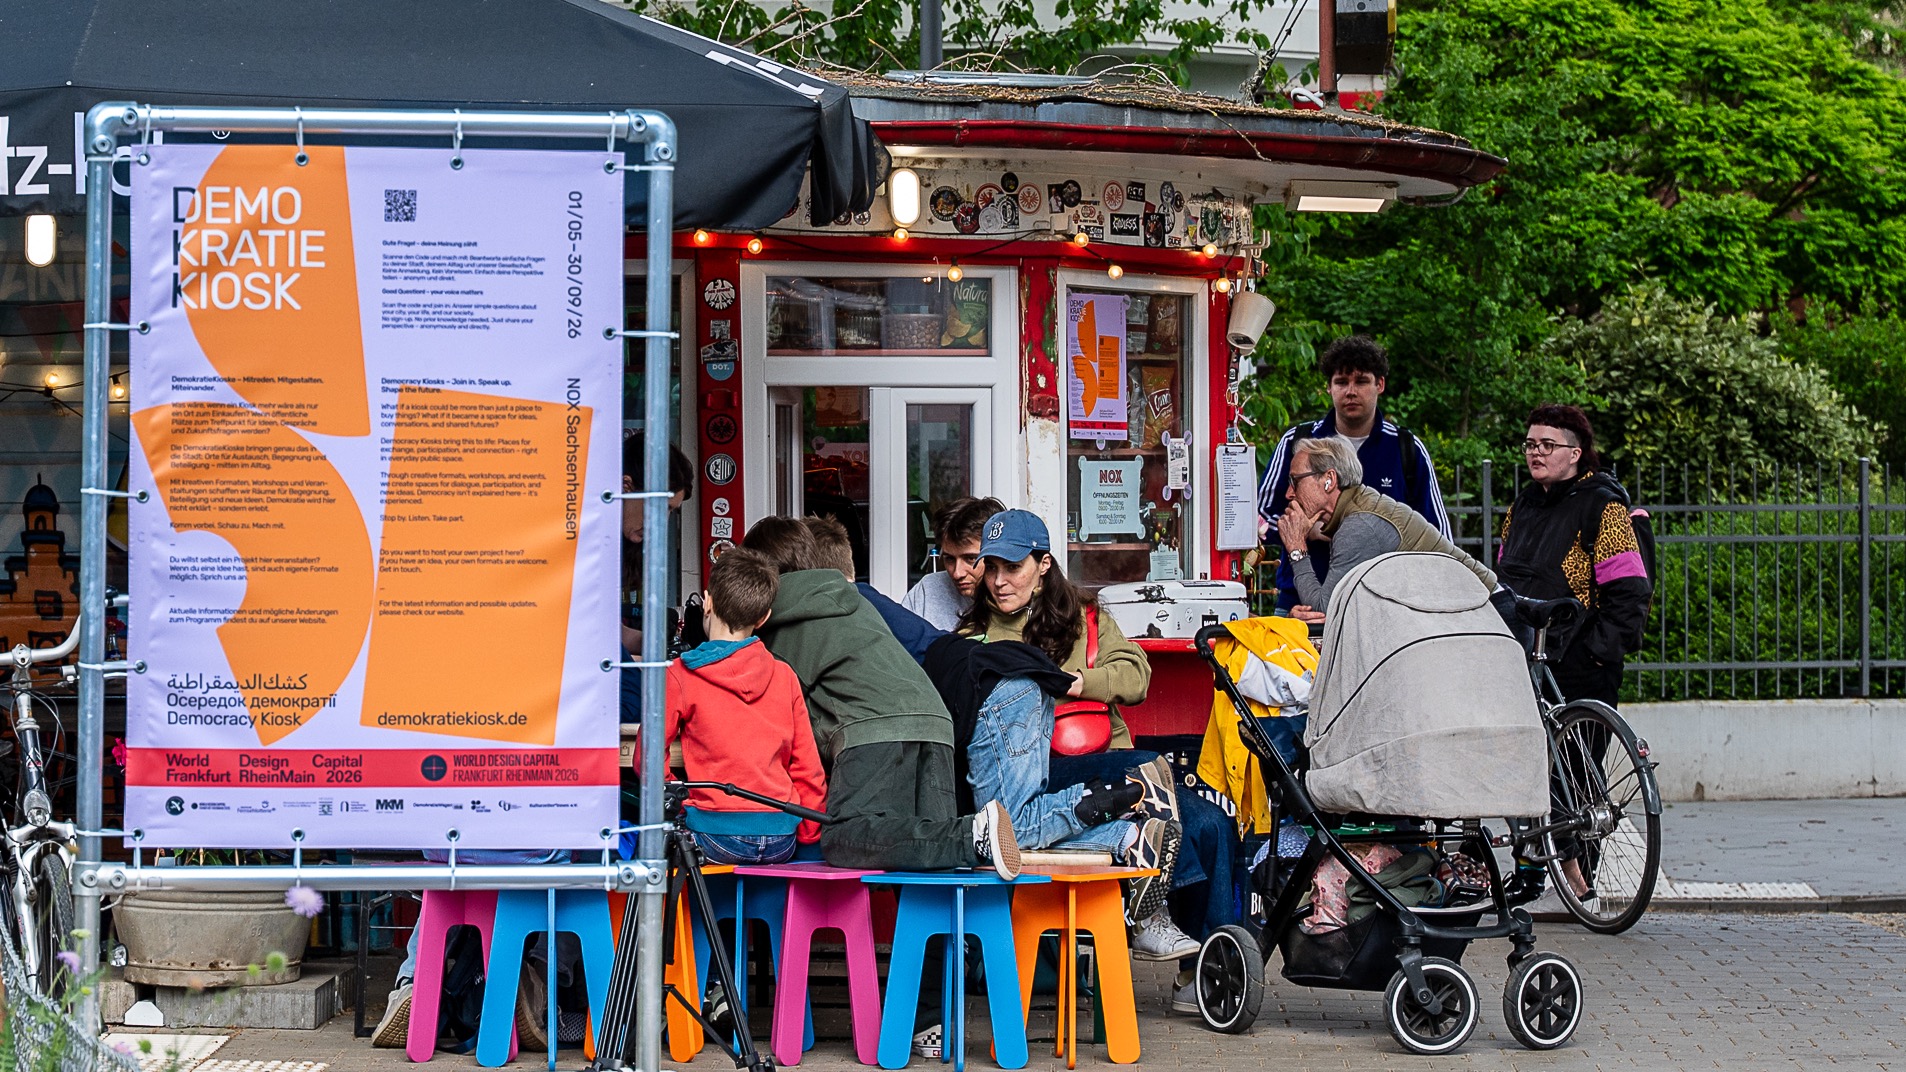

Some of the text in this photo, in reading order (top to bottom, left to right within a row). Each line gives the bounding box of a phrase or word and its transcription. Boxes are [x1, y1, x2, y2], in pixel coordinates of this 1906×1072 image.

[172, 186, 302, 224] DEMO
[172, 229, 326, 268] KRATIE
[172, 272, 302, 310] KIOSK
[566, 378, 580, 540] NOX Sachsenhausen
[1100, 470, 1122, 483] NOX
[167, 693, 337, 710] Осередок демократії
[168, 711, 302, 728] Democracy Kiosk
[377, 712, 527, 726] demokratiekiosk.de
[166, 754, 363, 771] World Design Capital
[453, 754, 560, 767] WORLD DESIGN CAPITAL
[166, 769, 362, 783] Frankfurt RheinMain 2026
[453, 768, 579, 782] FRANKFURT RHEINMAIN 2026
[376, 799, 404, 810] MKM
